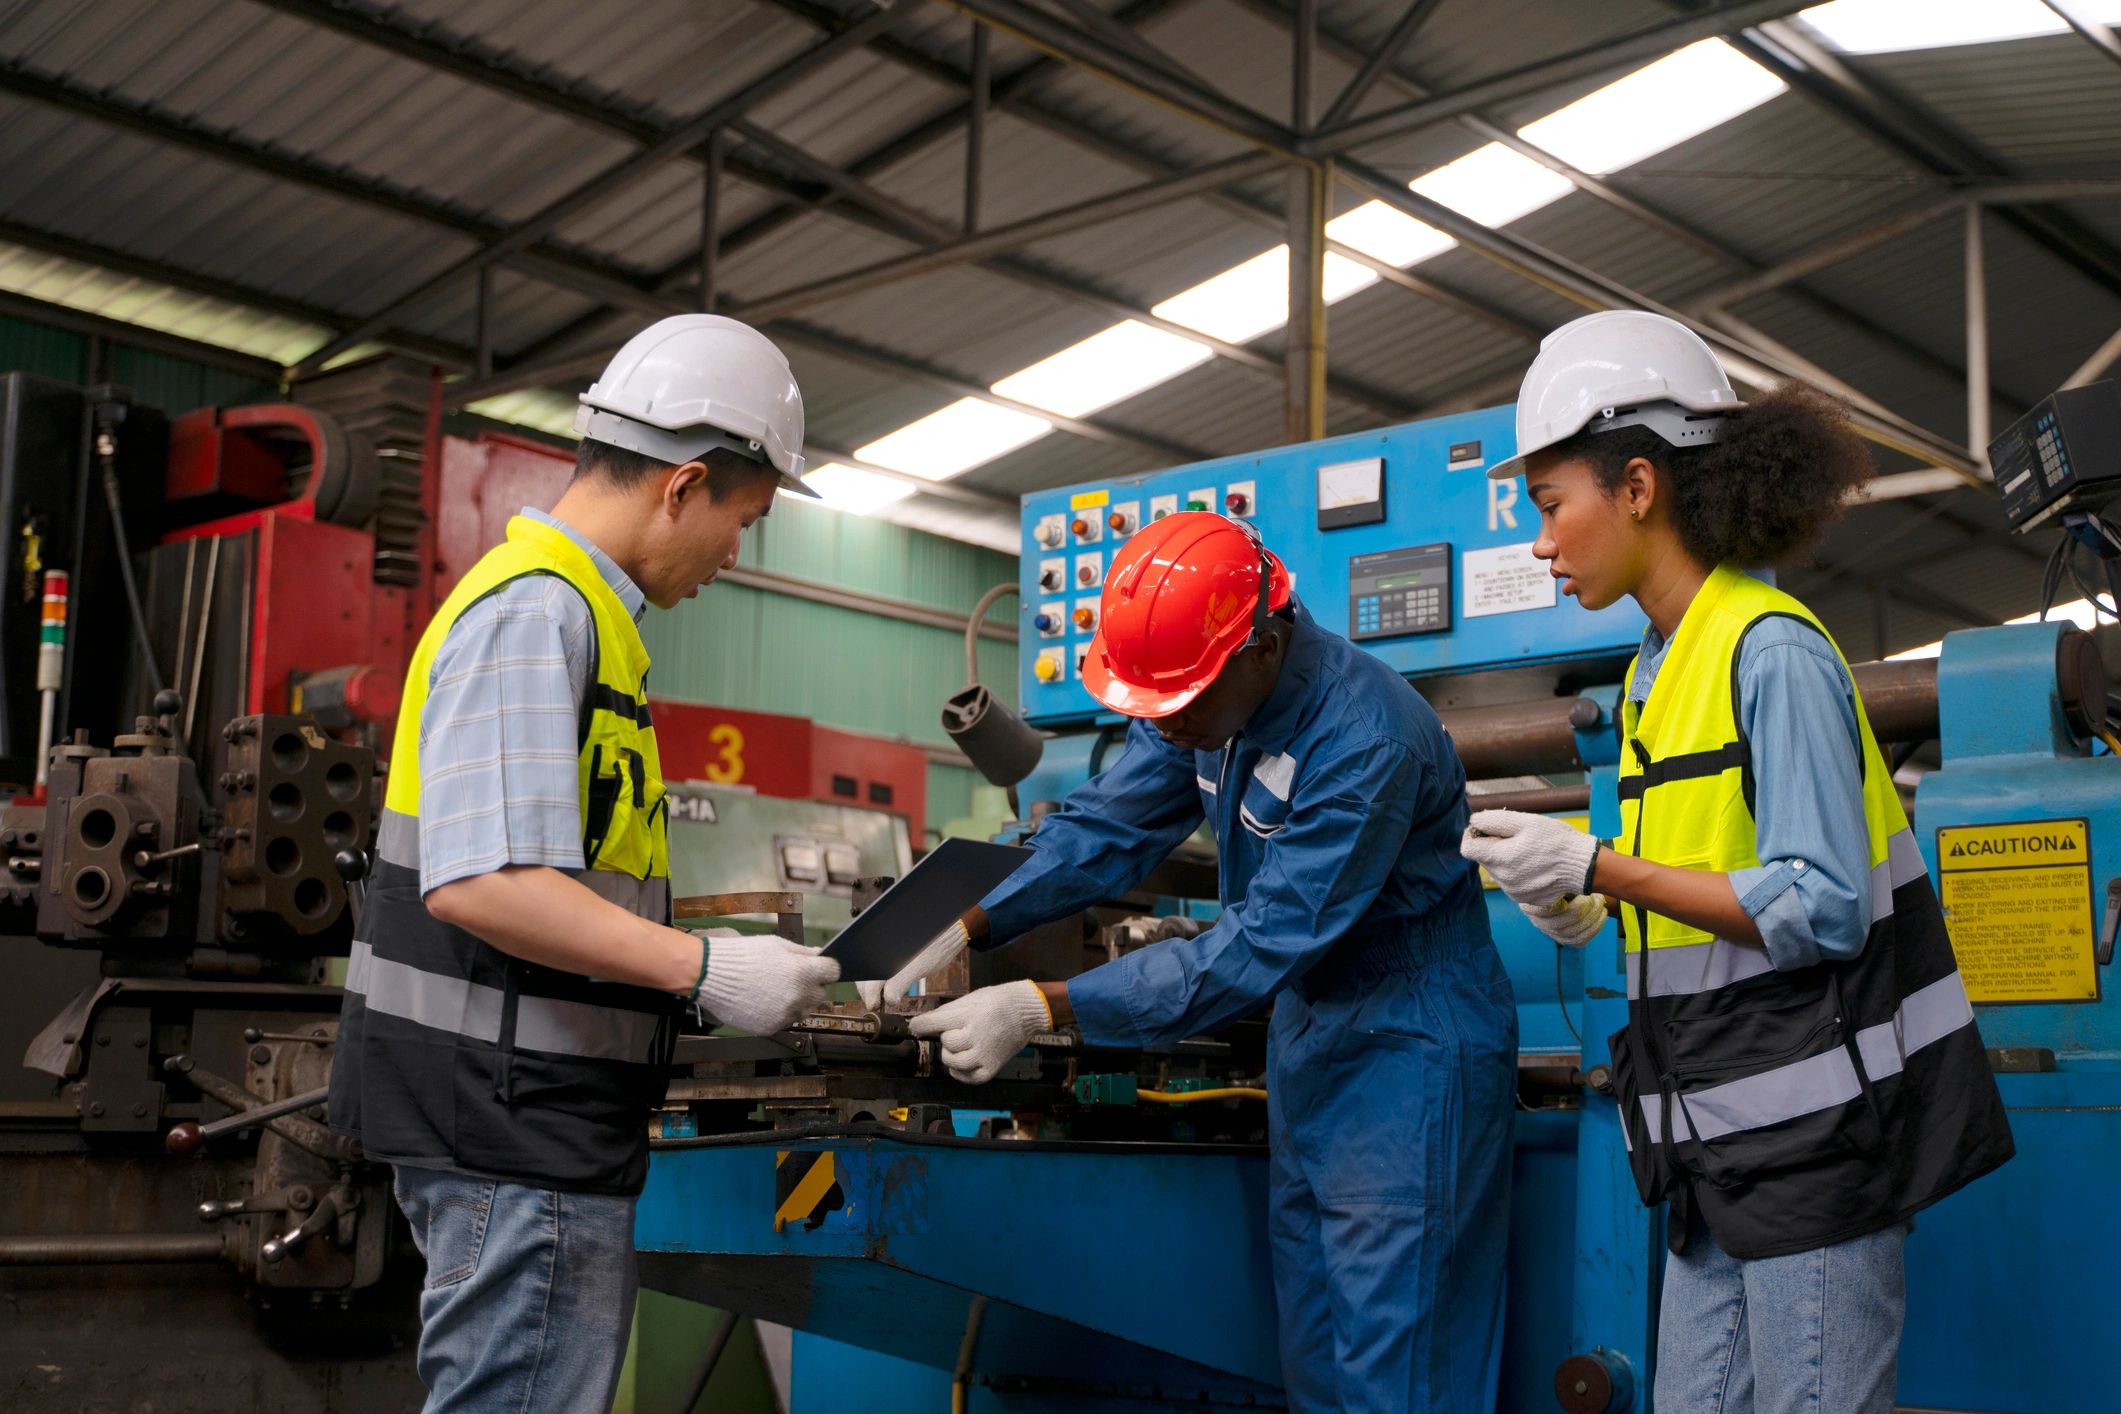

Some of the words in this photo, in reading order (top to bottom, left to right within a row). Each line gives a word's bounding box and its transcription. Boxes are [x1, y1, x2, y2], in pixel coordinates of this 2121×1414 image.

[1488, 478, 1518, 531] R
[705, 723, 745, 785] 3
[1967, 836, 2058, 856] CAUTION
[2052, 872, 2085, 880] PROPER
[2051, 880, 2072, 888] MUST
[1977, 900, 2016, 909] ENTERING
[2052, 904, 2081, 912] ENTIRE
[1976, 924, 2016, 932] PROPERLY
[2019, 922, 2052, 930] TRAINED
[1955, 939, 1989, 947] OPERATE
[1992, 938, 2009, 946] THIS
[2060, 945, 2073, 953] OR
[1988, 955, 2005, 963] THIS
[2007, 953, 2042, 962] MACHINE
[2044, 952, 2080, 961] WITHOUT
[2025, 970, 2056, 978] MANUAL
[2060, 969, 2076, 977] FOR
